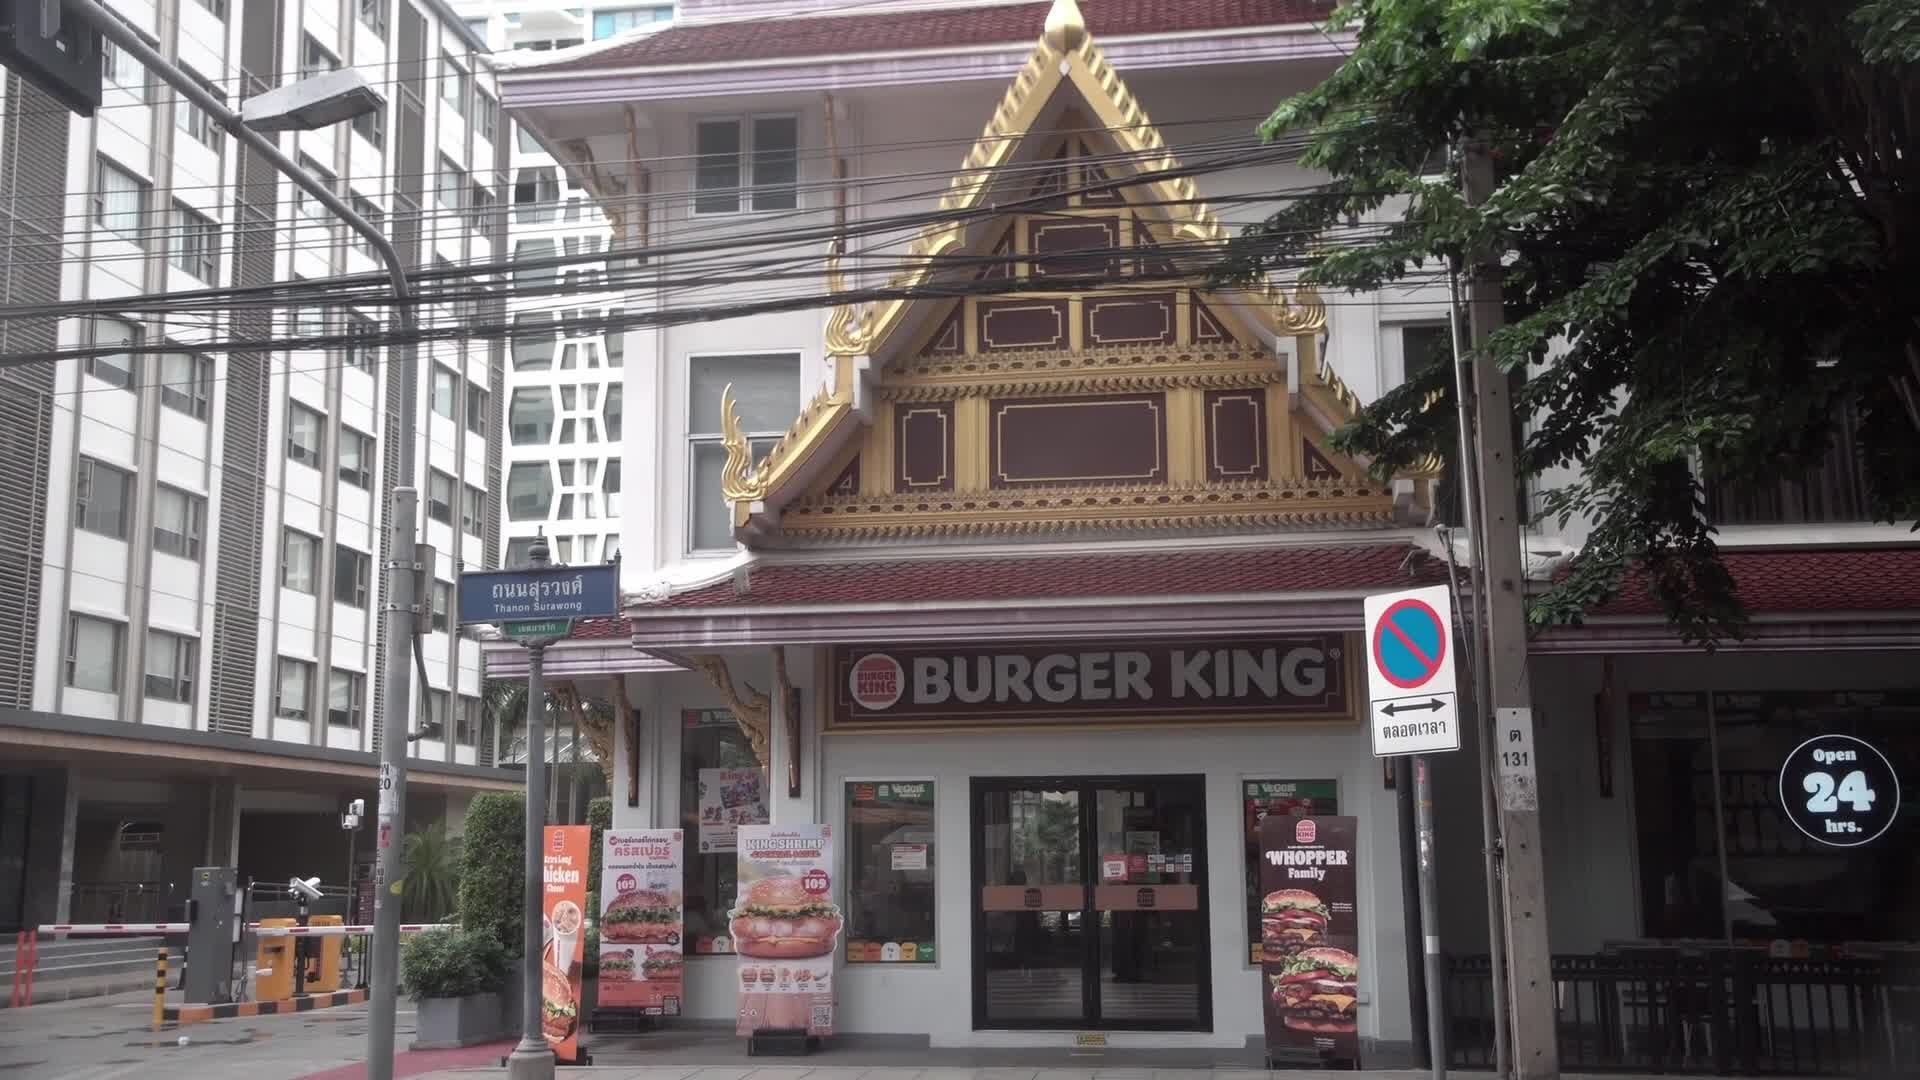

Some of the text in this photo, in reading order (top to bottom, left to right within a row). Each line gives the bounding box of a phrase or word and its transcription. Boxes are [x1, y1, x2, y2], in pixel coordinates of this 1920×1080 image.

[492, 574, 584, 601] ถนนสุรวงศ์
[494, 601, 582, 613] Thanon Surawong
[857, 671, 896, 681] BURGER
[913, 651, 1153, 705] BURGER
[857, 680, 897, 695] KING
[1383, 720, 1447, 739] ตลอดเวลา
[1502, 751, 1529, 767] 131
[1812, 748, 1857, 765] Open
[1802, 770, 1876, 812] 24
[1824, 819, 1863, 833] hrs.
[745, 839, 777, 849] KING
[778, 839, 825, 849] SHRIMP
[1265, 849, 1348, 866] WHOPPER
[544, 865, 580, 884] hicken
[1287, 867, 1326, 881] Family
[617, 880, 635, 890] 109
[804, 878, 827, 889] 109
